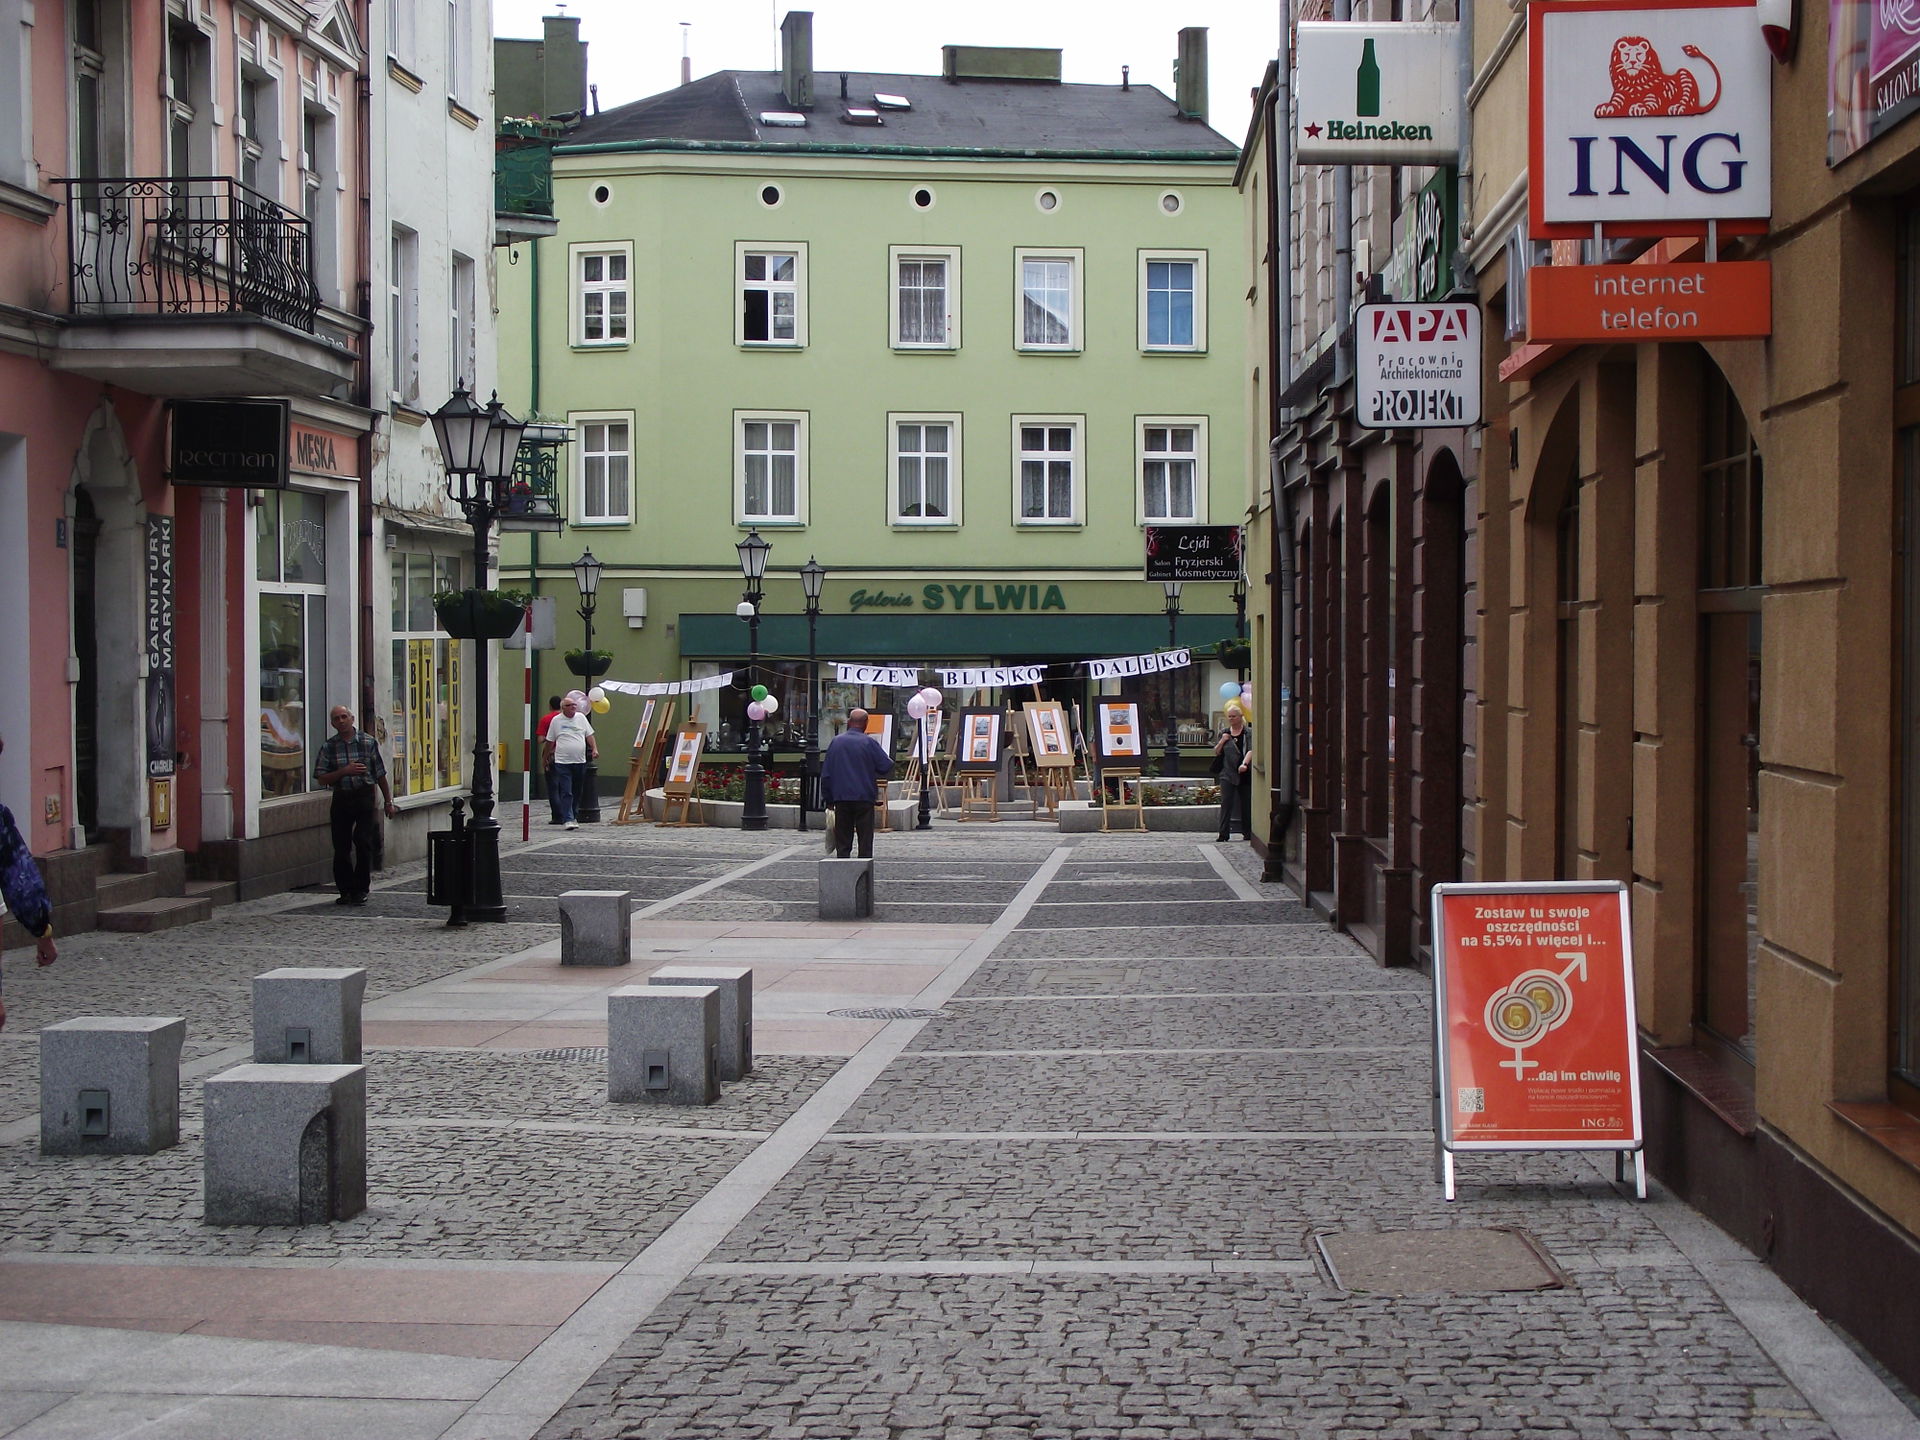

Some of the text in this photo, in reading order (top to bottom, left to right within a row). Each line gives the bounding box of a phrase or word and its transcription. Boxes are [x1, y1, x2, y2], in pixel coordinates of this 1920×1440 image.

[1877, 66, 1910, 117] SALON
[1327, 120, 1433, 141] Heineken
[1568, 132, 1748, 196] ING
[1421, 253, 1437, 298] PUB
[1594, 273, 1706, 296] internet
[1374, 309, 1467, 342] APA
[1600, 306, 1698, 330] telefon
[1378, 352, 1463, 368] Pracownia
[1380, 366, 1462, 380] Architektoniczna
[1372, 389, 1463, 421] PROJEKT
[297, 431, 337, 472] MĘSKA
[1178, 535, 1210, 553] Lejdi
[1175, 556, 1224, 568] Fryzjerski
[1175, 569, 1239, 580] Kosmetyczny
[149, 521, 160, 669] GARNITURY
[162, 518, 172, 669] MARYNARKI
[849, 584, 1066, 612] Galeria SYLWIA
[840, 651, 1190, 685] TCZEW BLISKO DALEKO
[1475, 906, 1590, 920] Zostaw tu swoje
[1486, 920, 1580, 934] oszczędności
[1461, 936, 1478, 946] na
[1483, 935, 1522, 948] 5,5%
[1536, 934, 1583, 948] więcej
[1508, 1005, 1524, 1029] 5
[1527, 1070, 1620, 1082] ...daj im chwilę
[1581, 1118, 1606, 1128] ING
